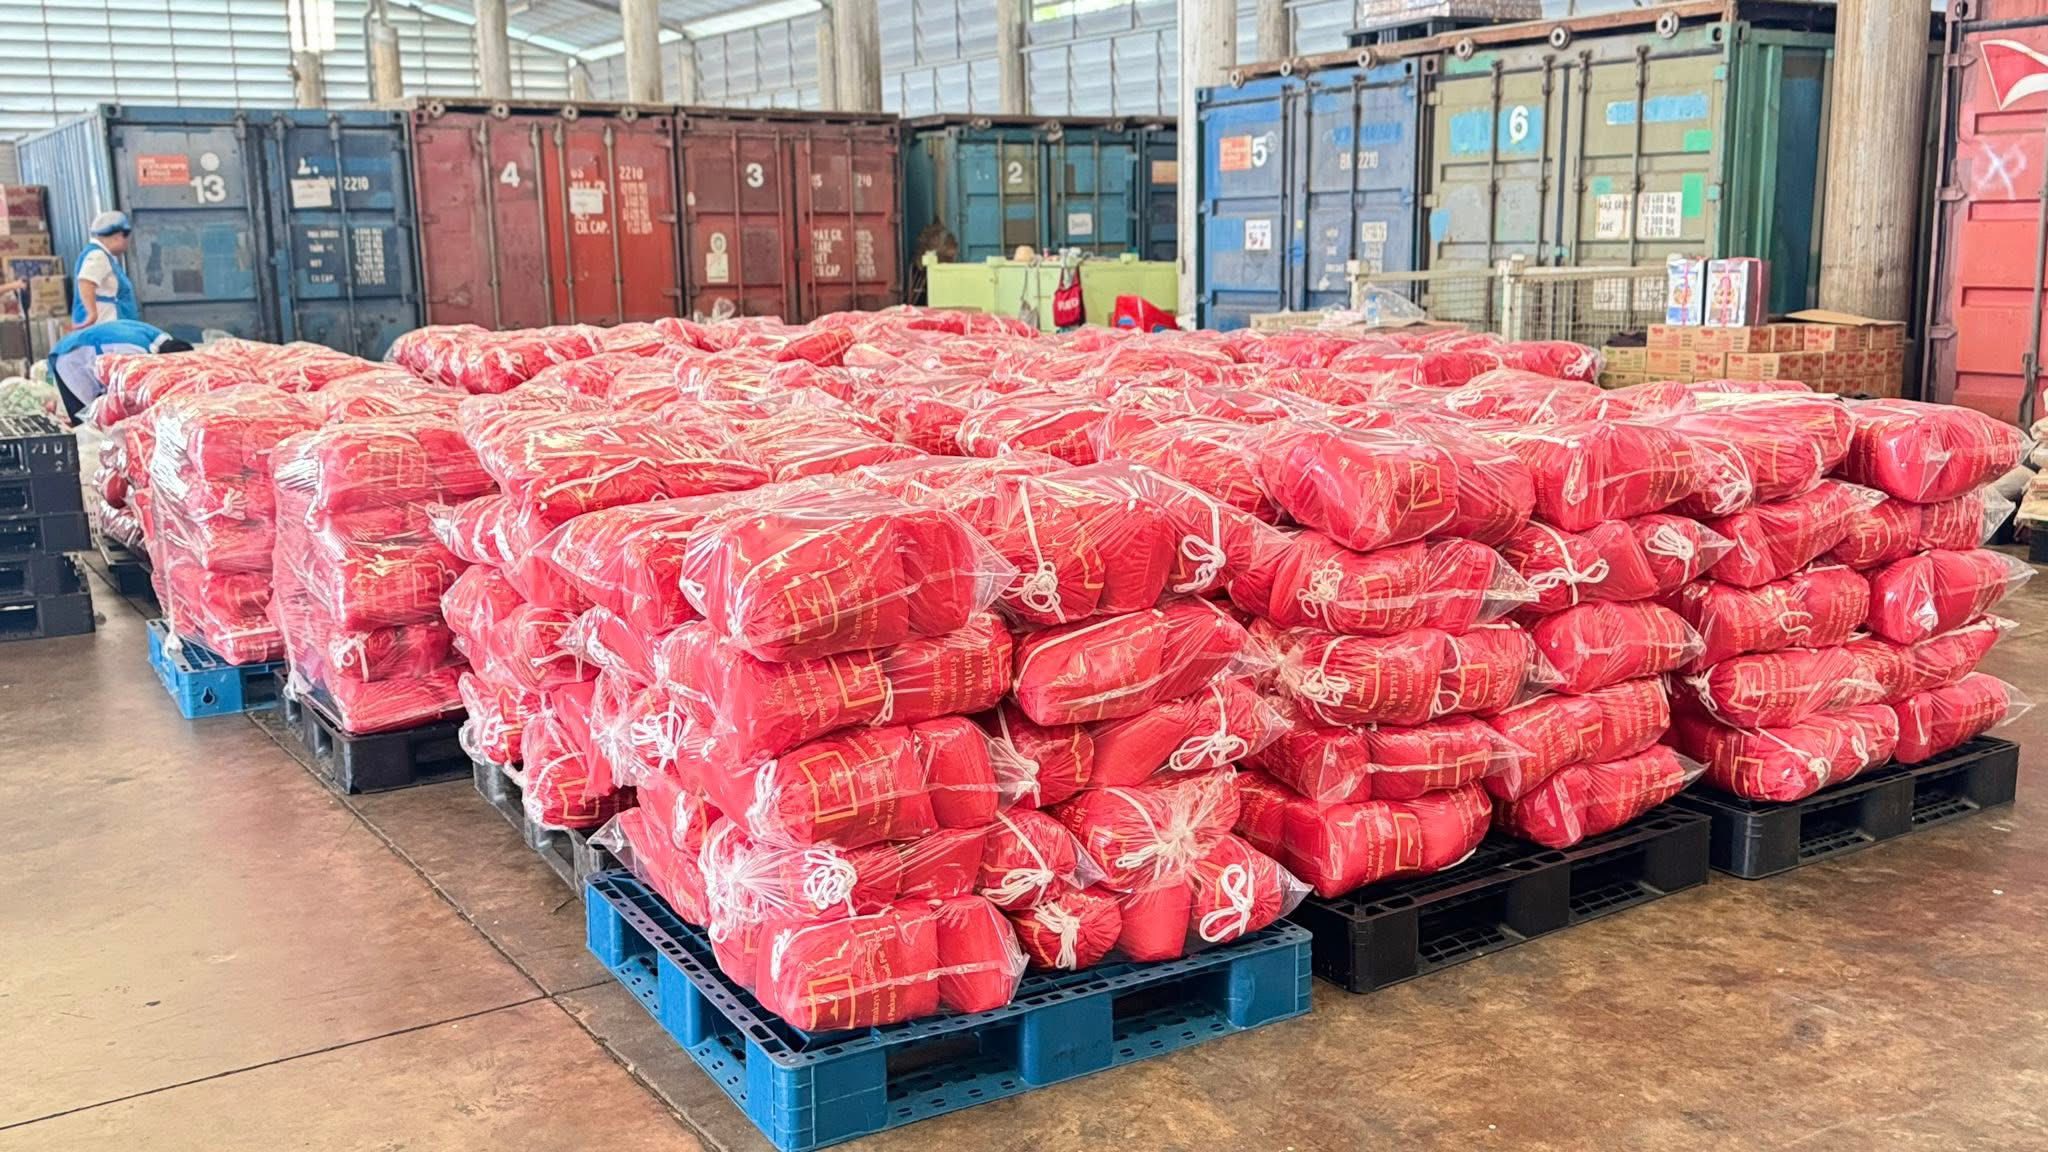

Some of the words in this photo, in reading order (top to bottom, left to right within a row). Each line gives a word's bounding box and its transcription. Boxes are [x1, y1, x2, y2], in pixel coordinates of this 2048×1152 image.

[1509, 105, 1528, 141] 6
[1253, 136, 1267, 168] 5
[500, 161, 520, 187] 4
[619, 167, 643, 180] 2210
[746, 163, 764, 187] 3
[1008, 161, 1024, 184] 2
[190, 175, 226, 204] 13
